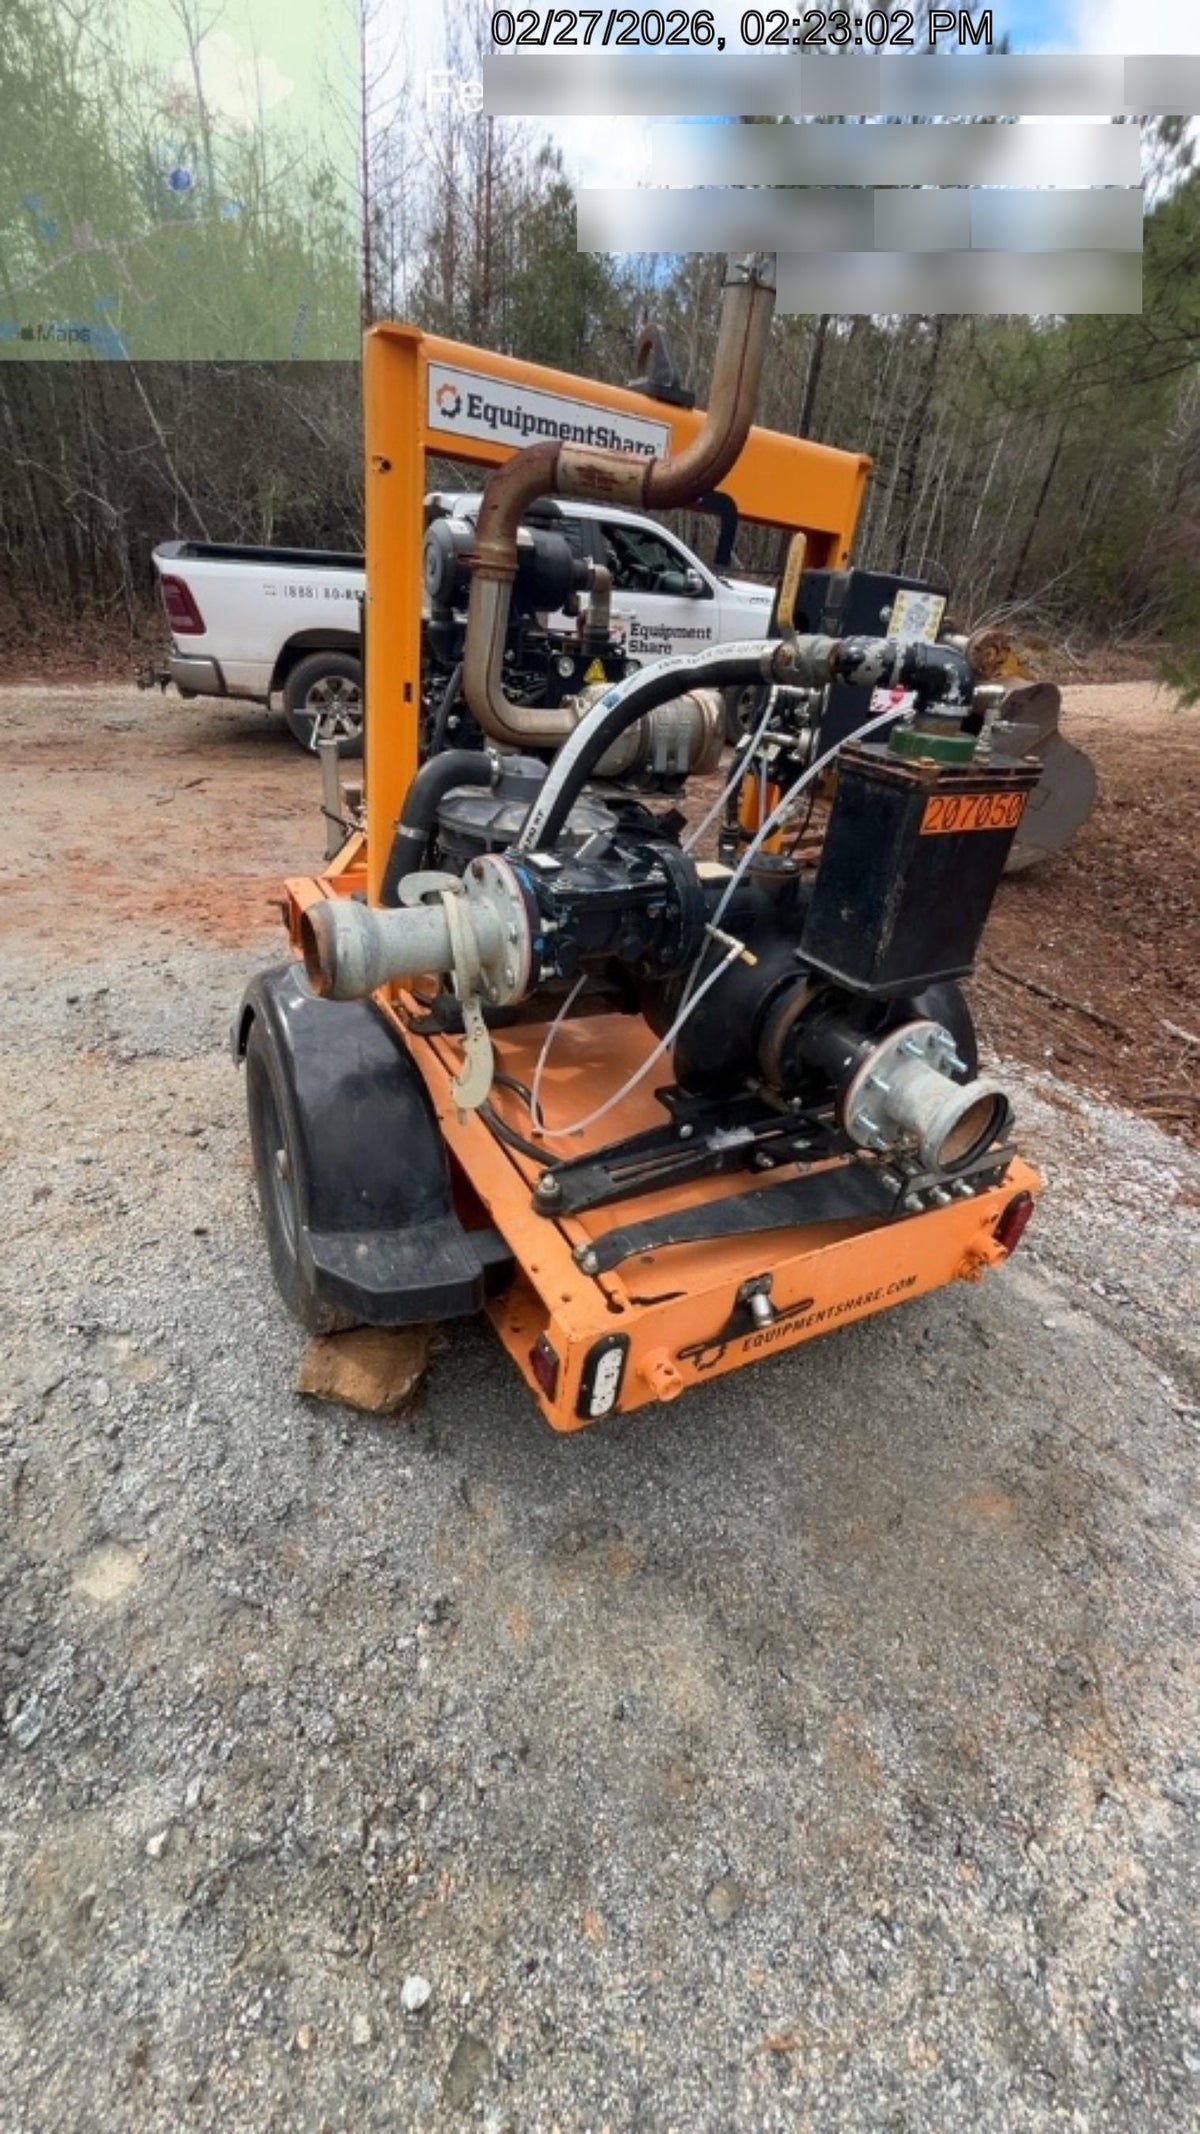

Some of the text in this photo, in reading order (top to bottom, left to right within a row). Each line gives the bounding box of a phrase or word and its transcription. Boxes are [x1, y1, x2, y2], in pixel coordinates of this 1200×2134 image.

[466, 392, 657, 457] EquipmentShare
[628, 639, 673, 655] Share
[629, 622, 713, 641] Equipment
[923, 793, 1023, 830] 207050
[742, 1274, 918, 1352] EQUIPMENTSHARE.COM
